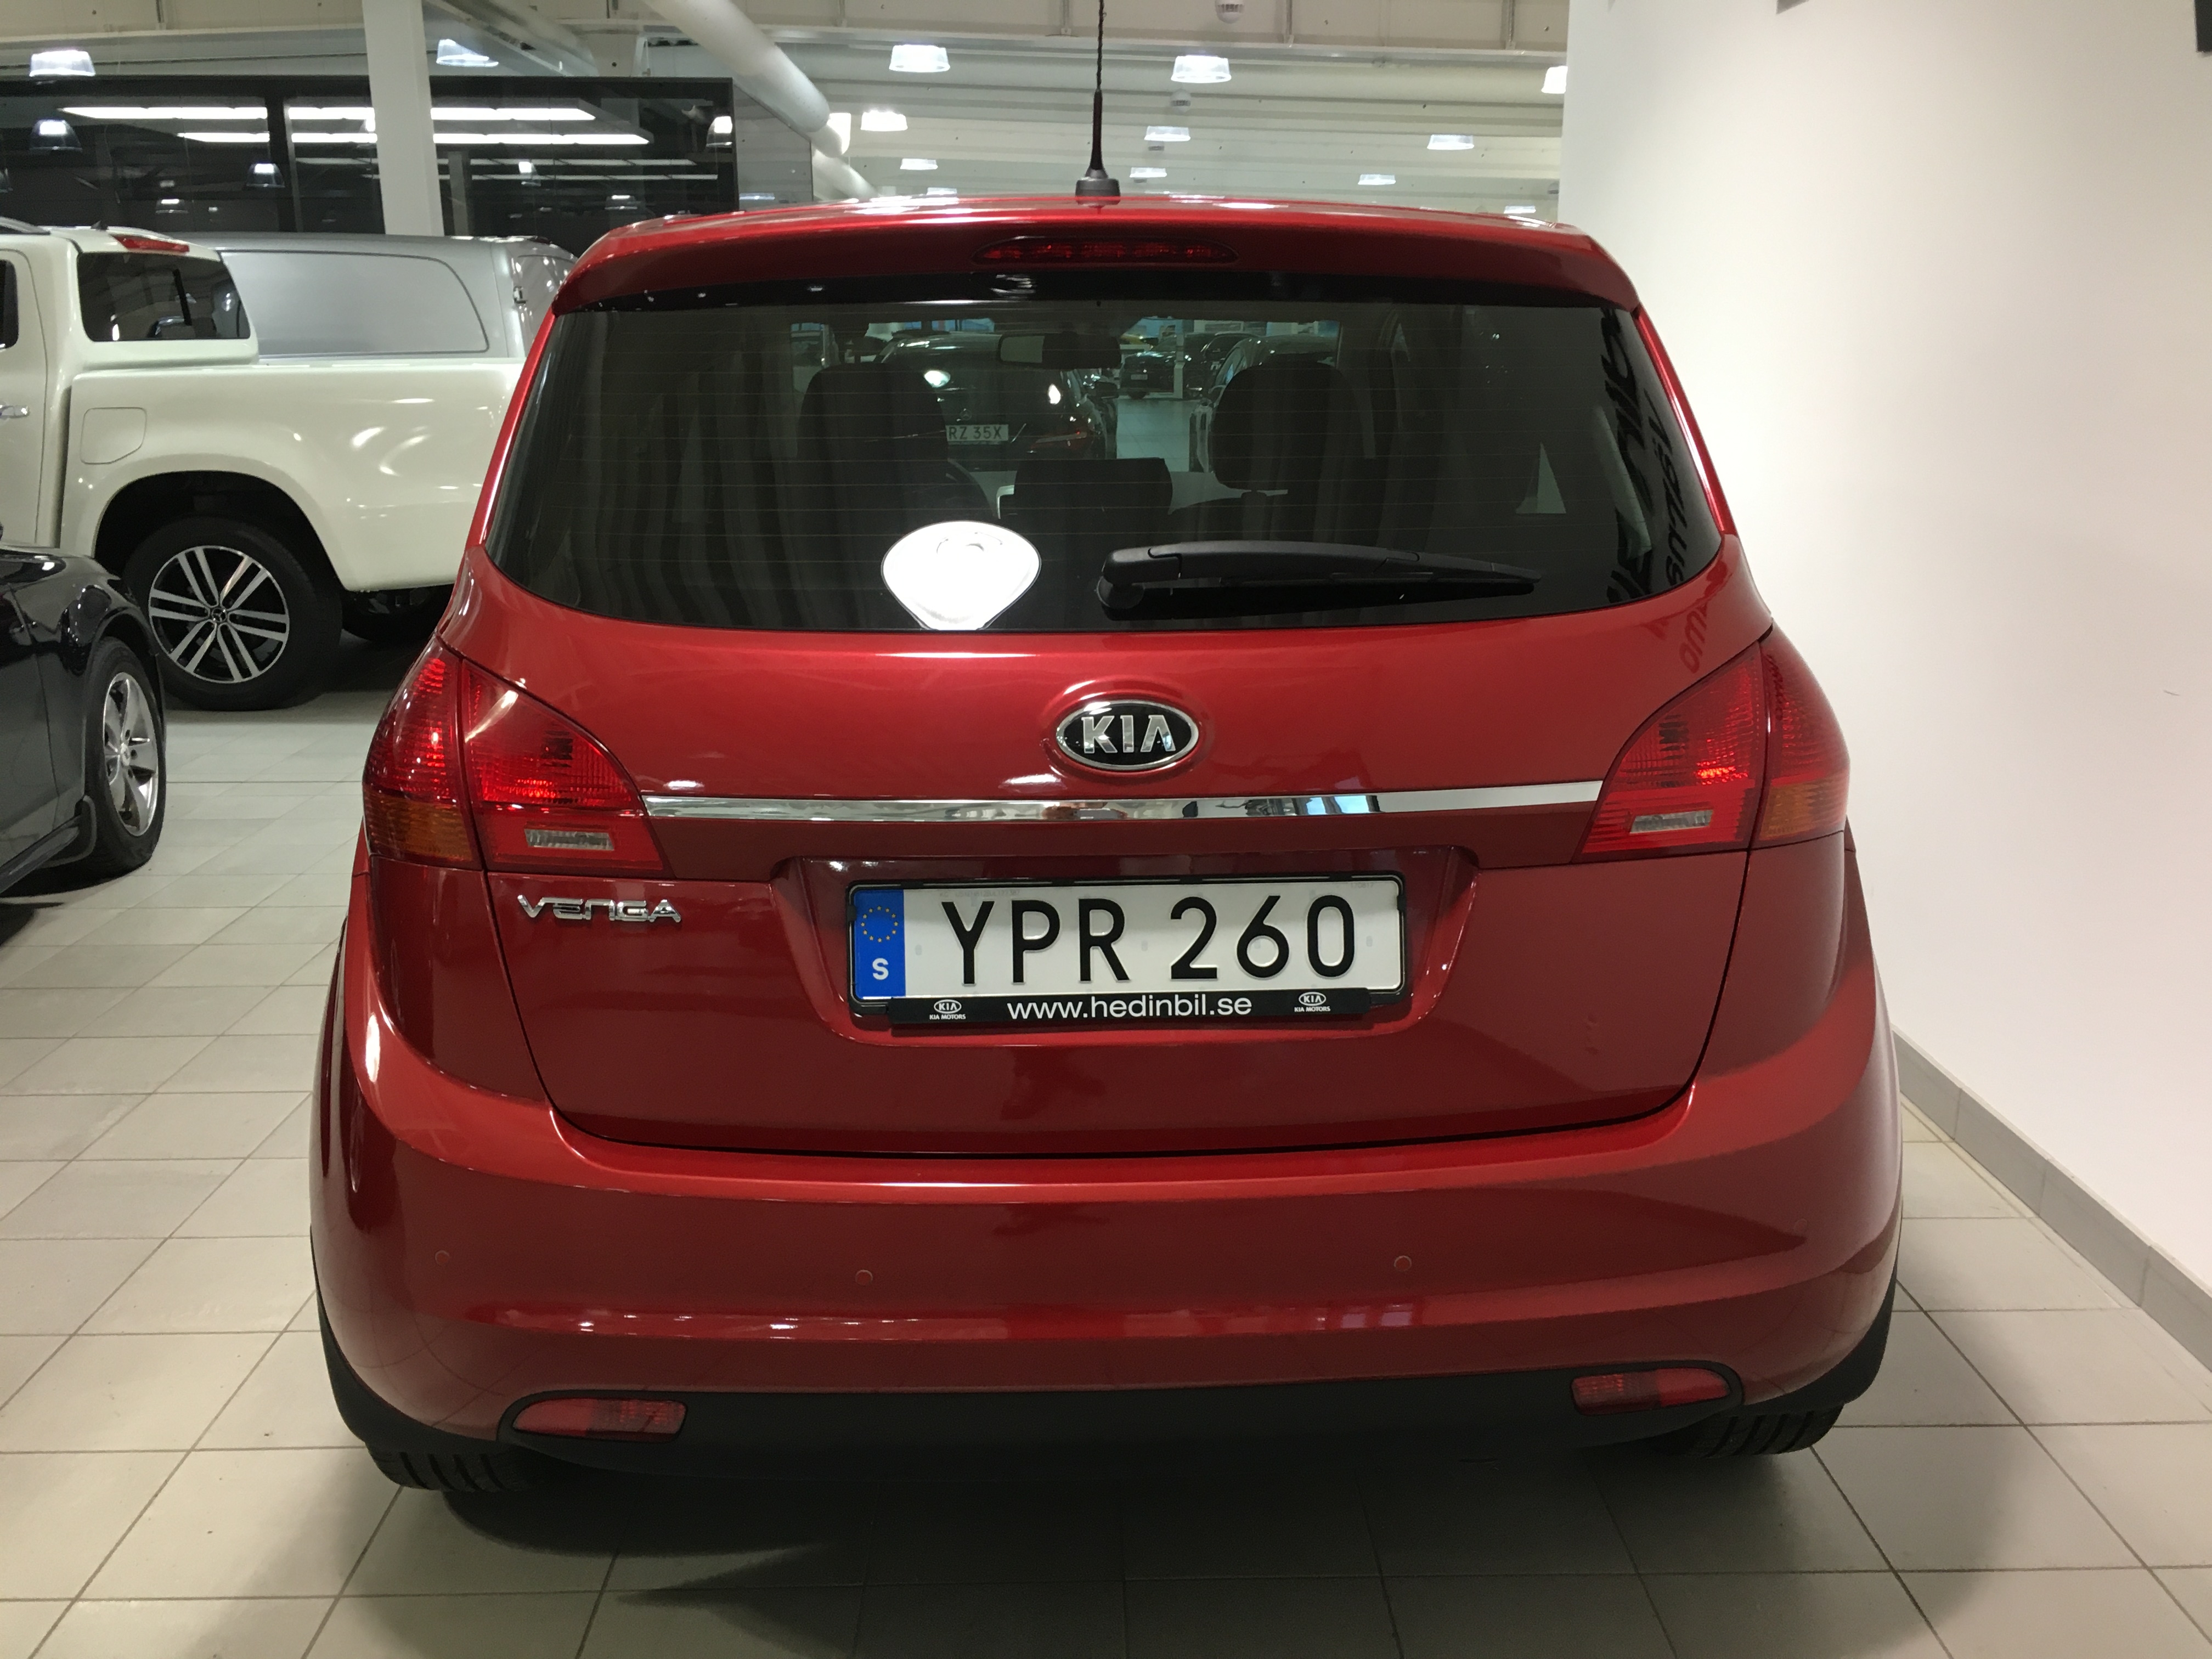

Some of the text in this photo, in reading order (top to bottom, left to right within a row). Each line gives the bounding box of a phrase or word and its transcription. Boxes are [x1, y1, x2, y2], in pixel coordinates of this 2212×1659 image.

[973, 426, 1001, 439] 35X
[1081, 715, 1176, 753] KIA
[517, 894, 681, 922] VENGA
[941, 895, 1355, 984] YPR 260
[872, 958, 889, 980] S
[939, 1002, 957, 1011] KIA
[1007, 994, 1252, 1019] www.hedinbil.se
